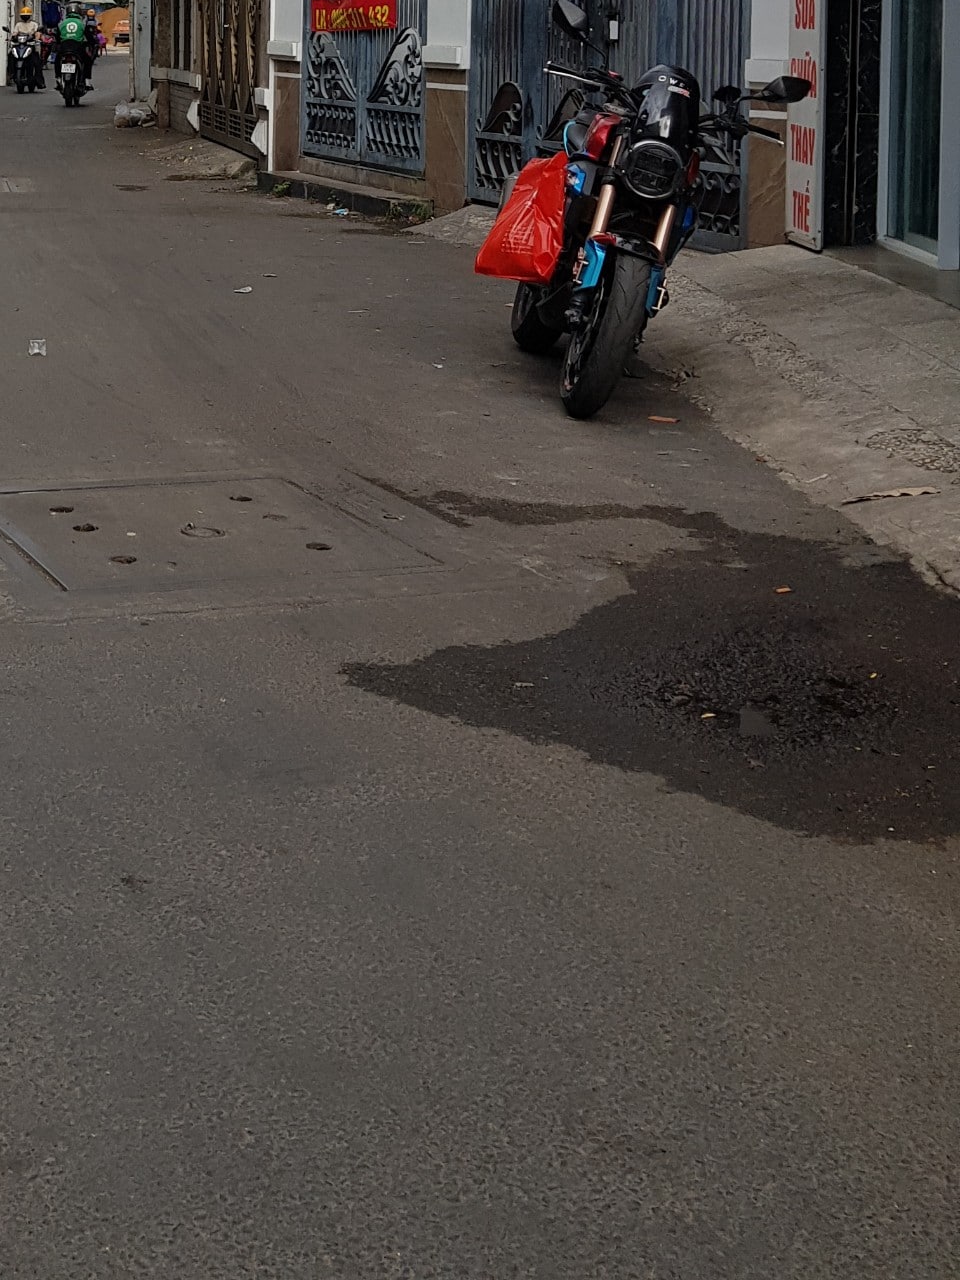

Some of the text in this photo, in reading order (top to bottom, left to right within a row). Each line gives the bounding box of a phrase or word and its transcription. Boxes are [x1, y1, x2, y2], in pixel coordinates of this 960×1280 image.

[368, 5, 389, 27] 432
[791, 123, 816, 166] THAY
[792, 179, 810, 233] THẾ
